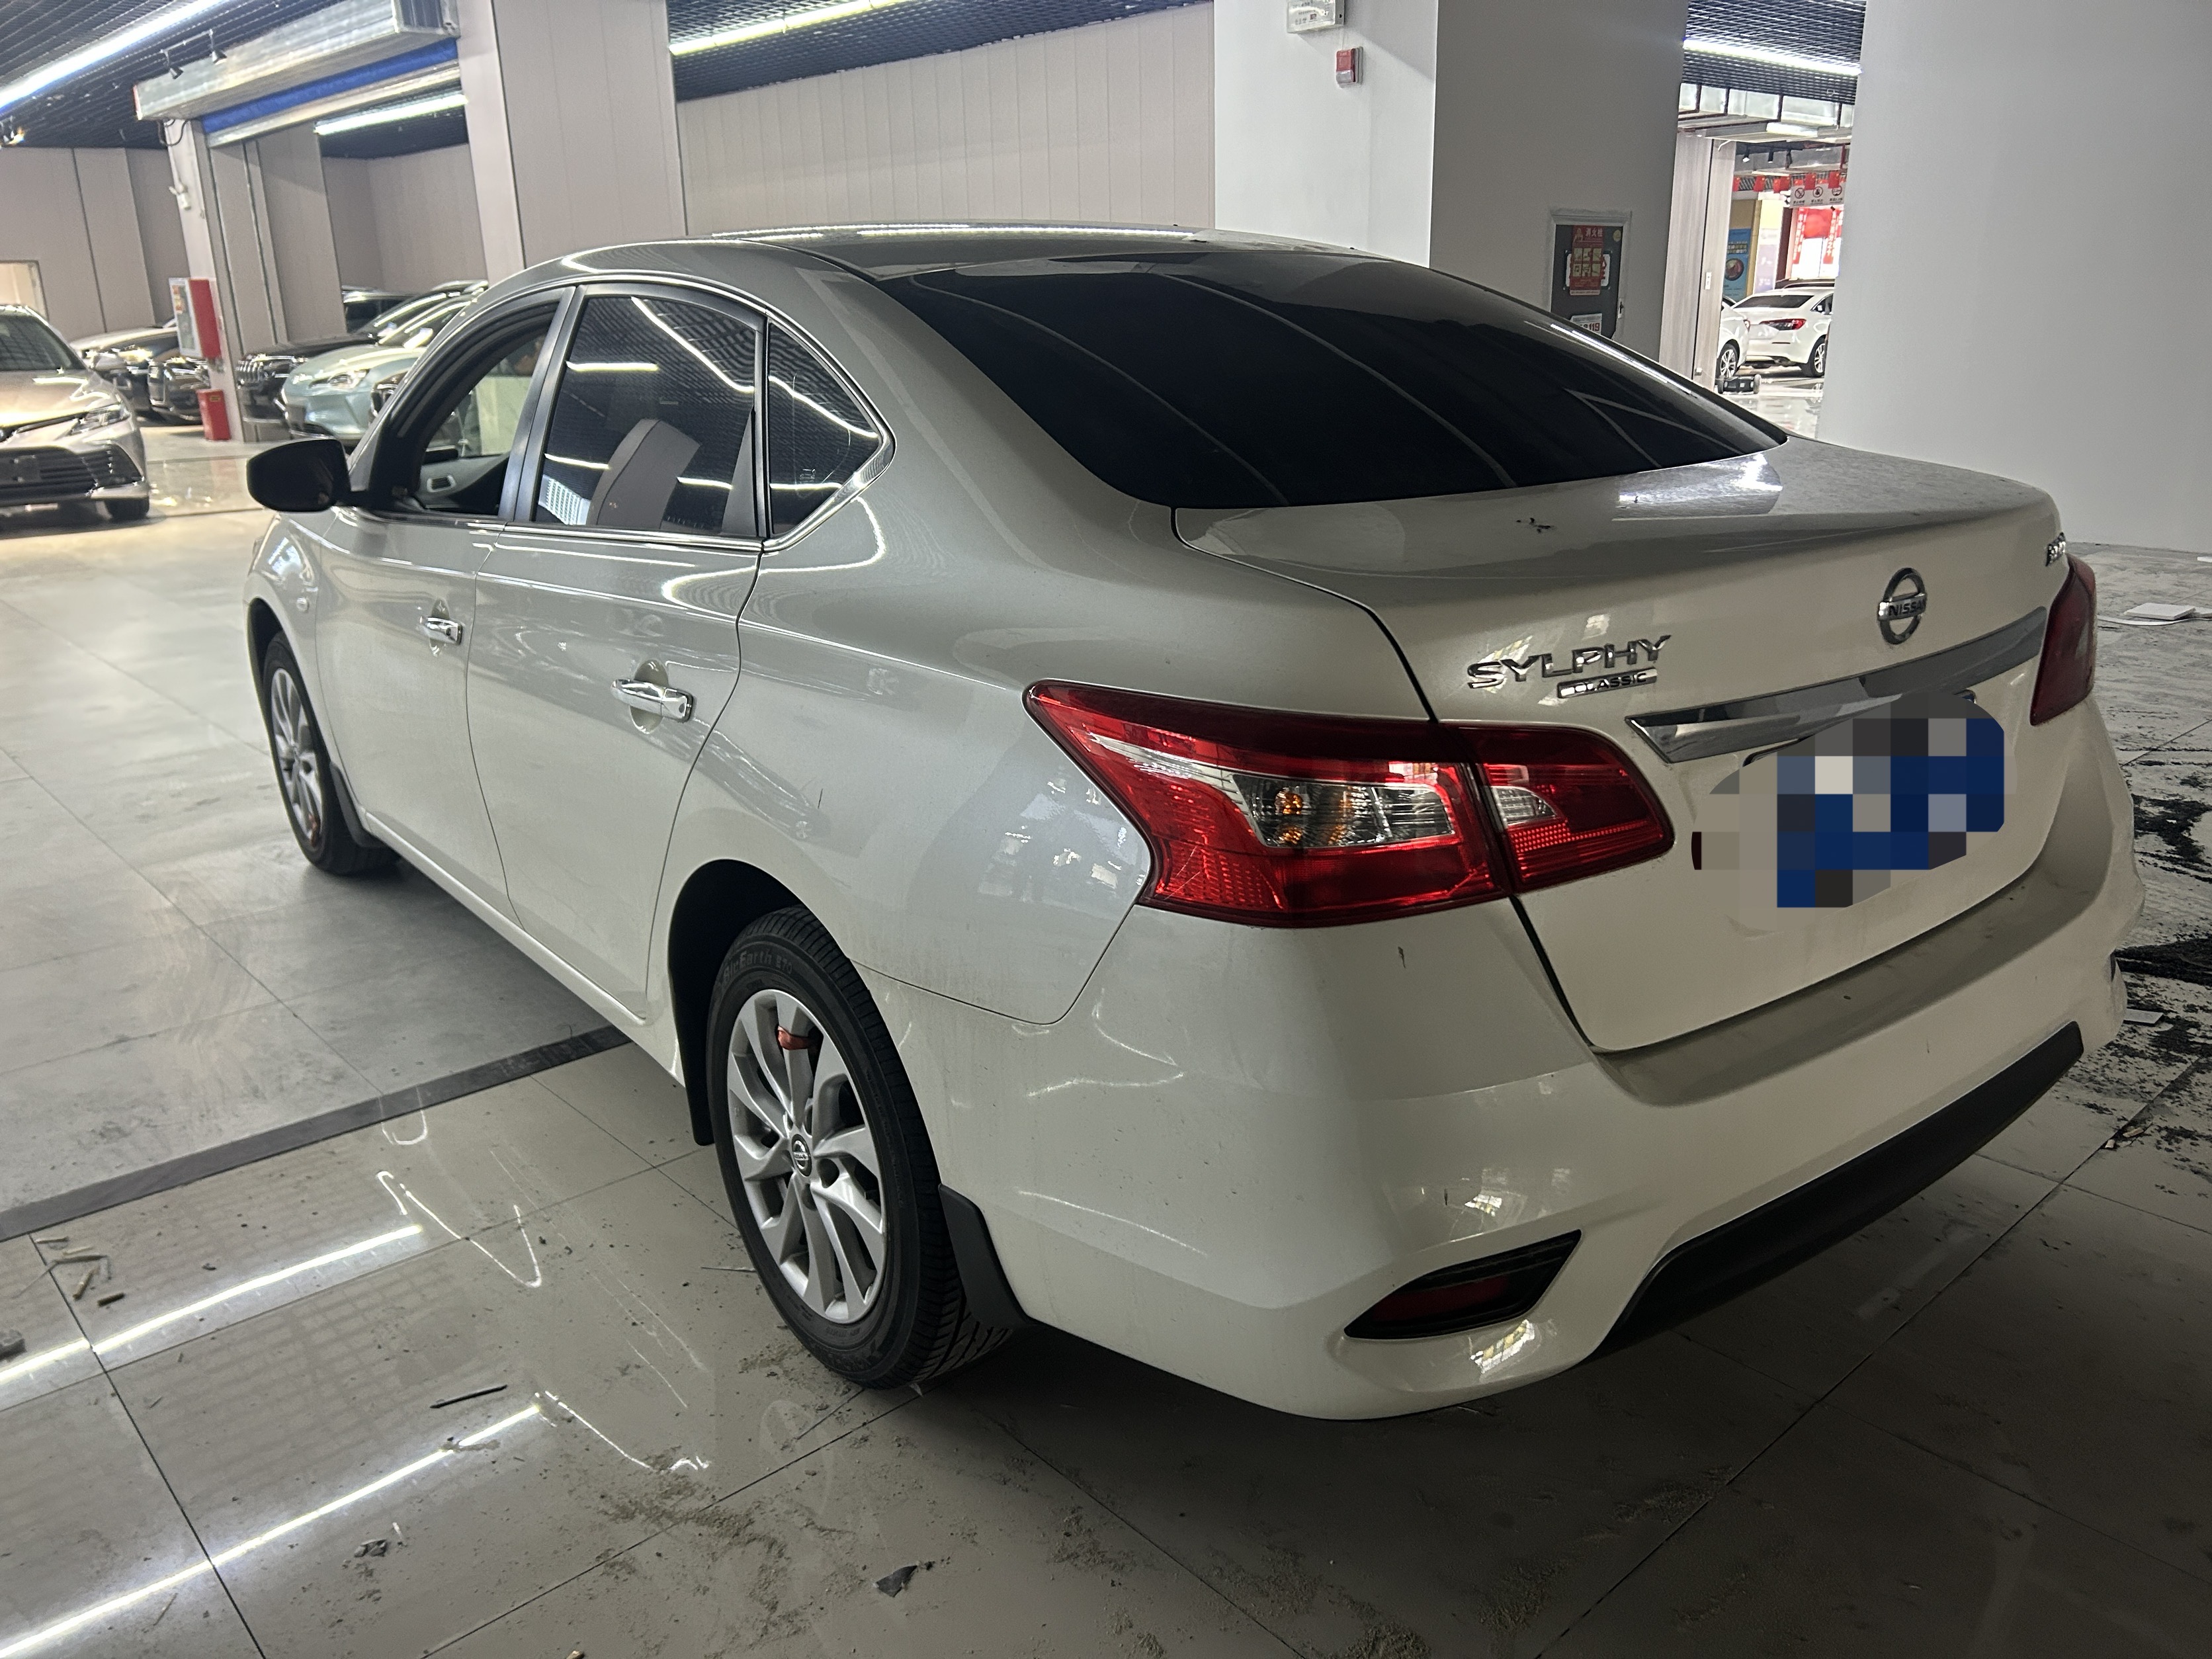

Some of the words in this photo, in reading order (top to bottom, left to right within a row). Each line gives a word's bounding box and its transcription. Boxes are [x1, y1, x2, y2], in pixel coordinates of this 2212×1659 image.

[1589, 322, 1600, 331] 119
[1467, 634, 1672, 689] SYLPHY
[1574, 672, 1648, 693] CLASSIC
